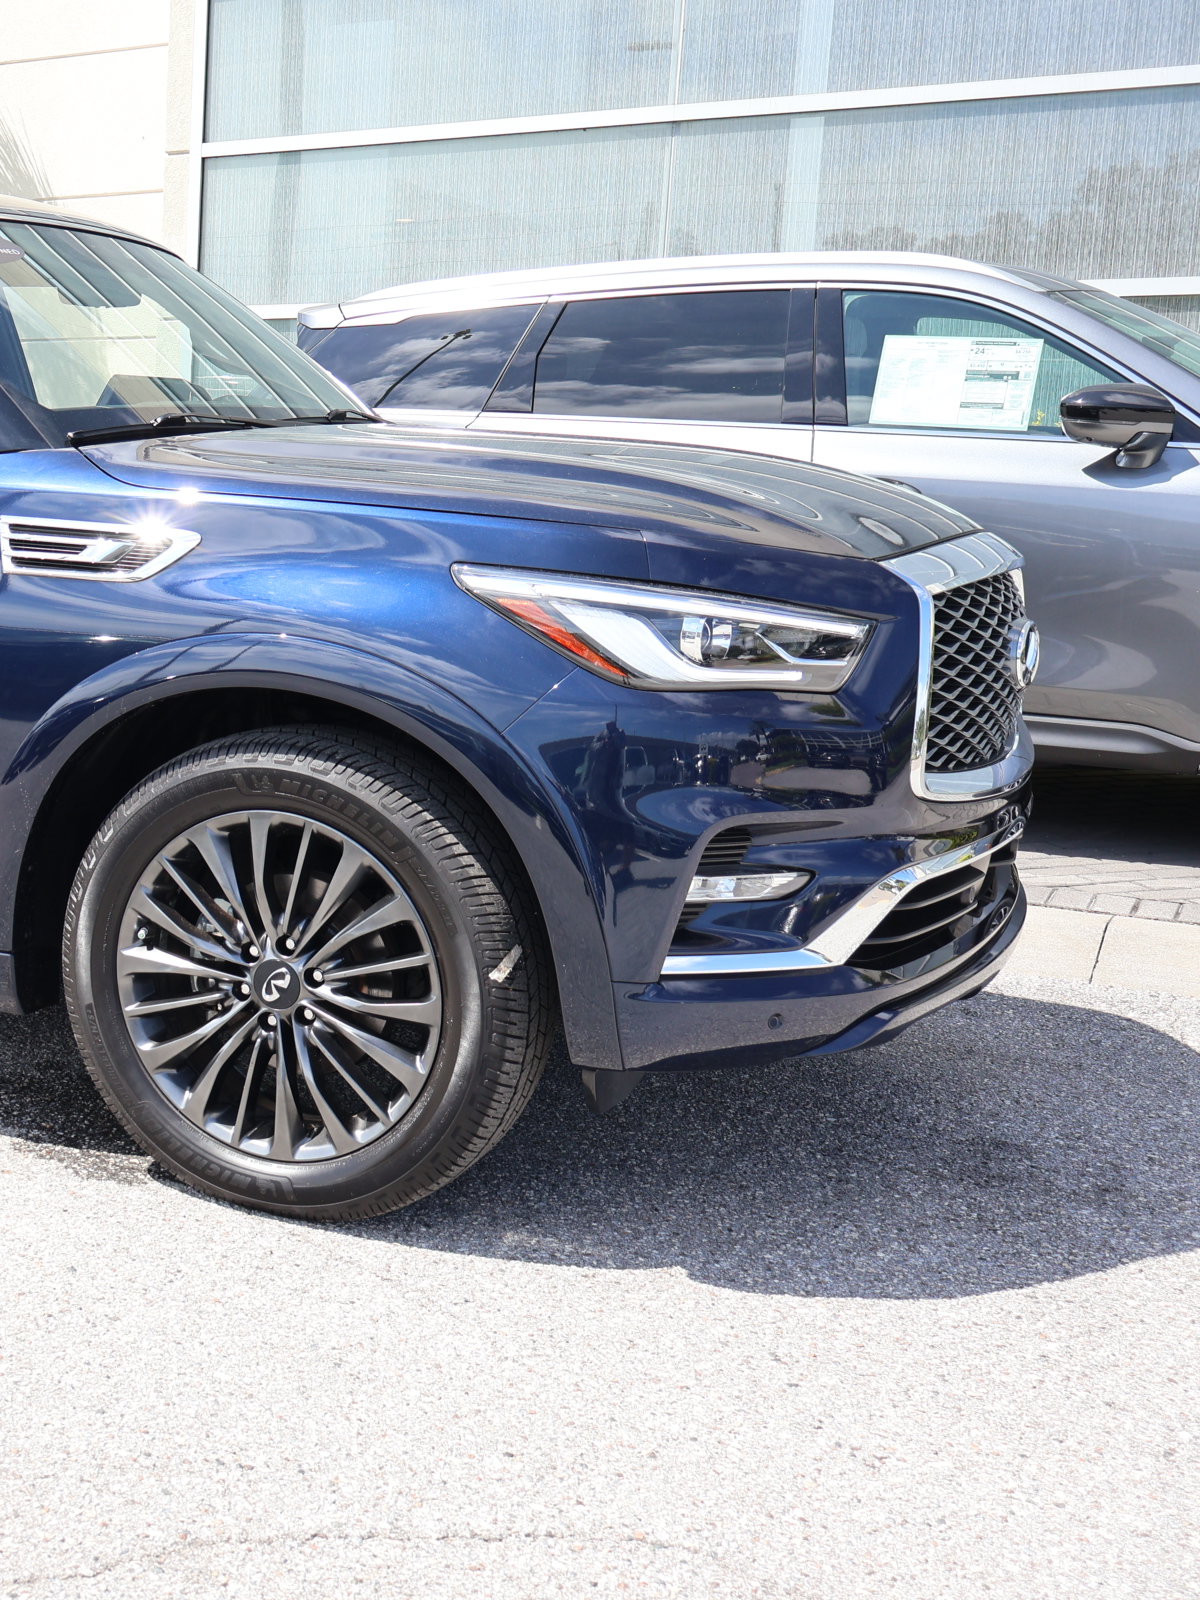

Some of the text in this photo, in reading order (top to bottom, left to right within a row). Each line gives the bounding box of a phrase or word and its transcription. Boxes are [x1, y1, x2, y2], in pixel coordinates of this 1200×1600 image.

[974, 347, 986, 355] 24
[279, 778, 400, 849] MICHELIN
[144, 1117, 252, 1190] MICHELIN
